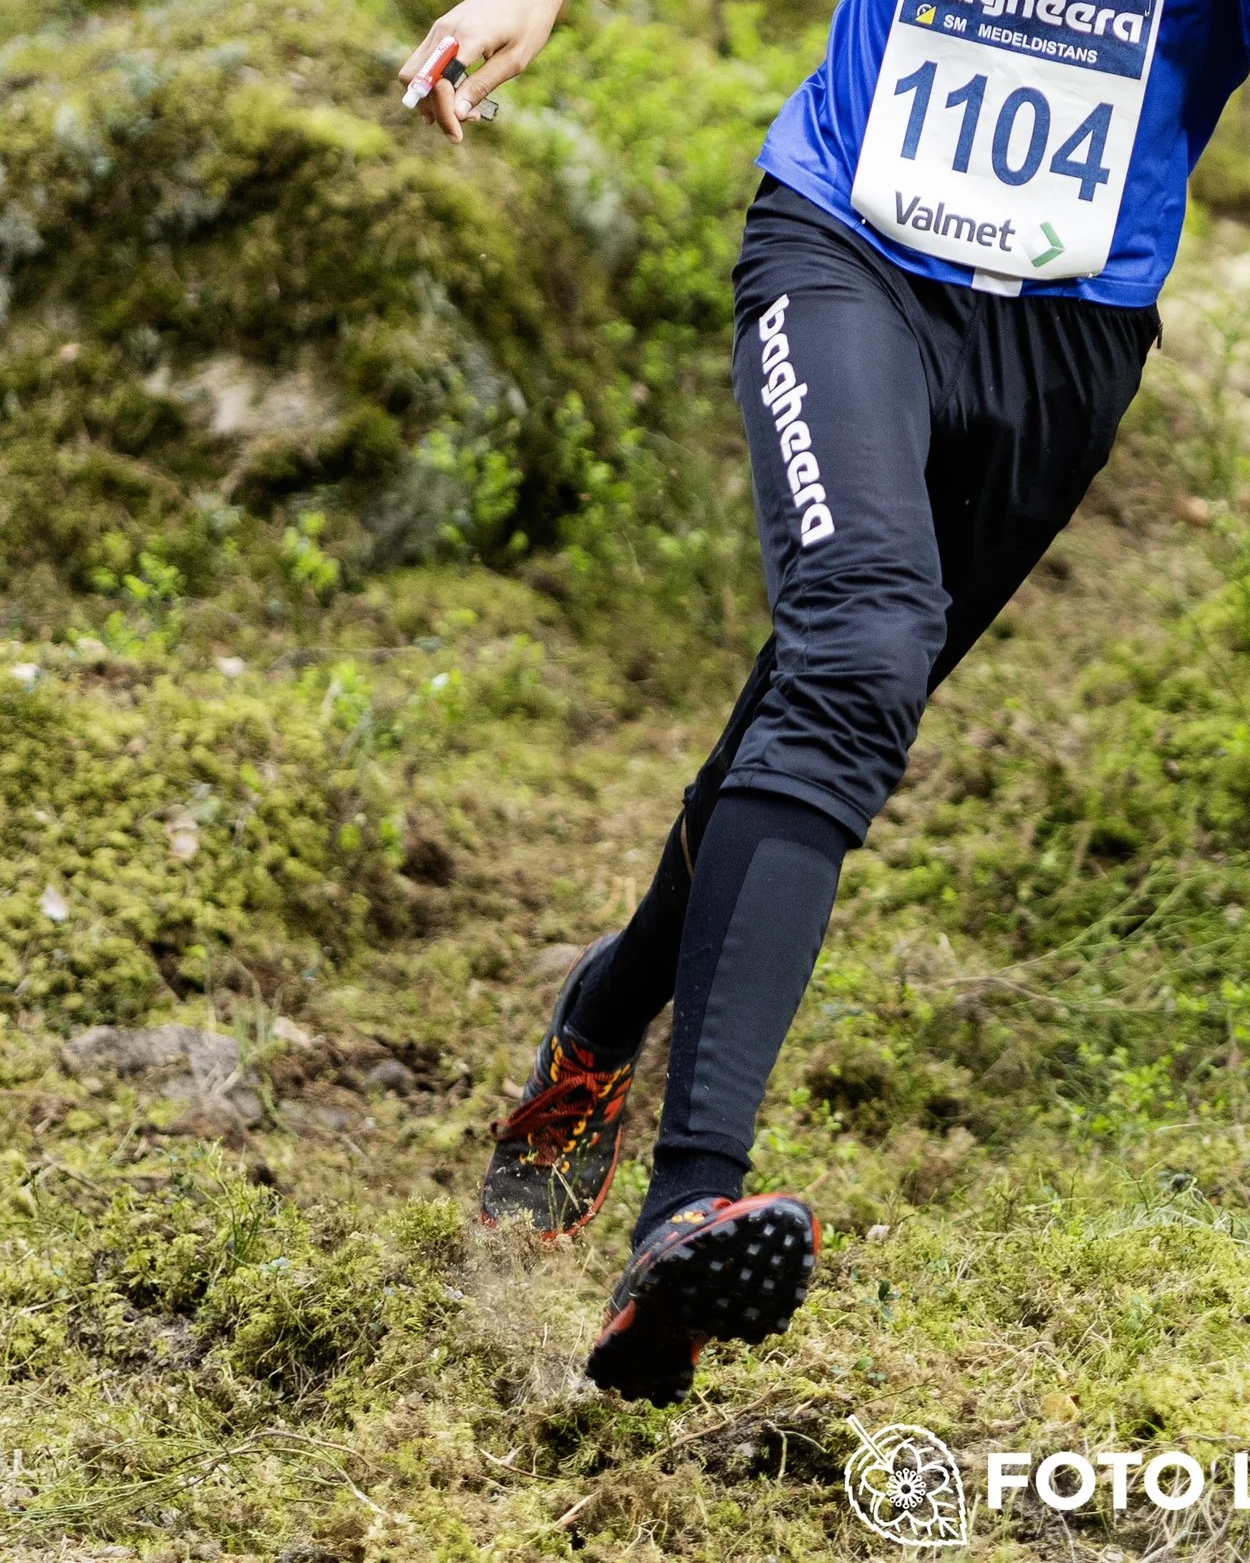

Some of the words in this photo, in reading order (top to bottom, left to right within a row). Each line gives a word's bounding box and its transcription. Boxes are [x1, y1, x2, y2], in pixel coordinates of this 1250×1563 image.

[943, 13, 967, 32] SM
[978, 22, 1099, 65] MEDELDISTANS
[893, 59, 1116, 203] 1104
[894, 189, 1016, 253] Valmet
[759, 294, 835, 547] bagheera
